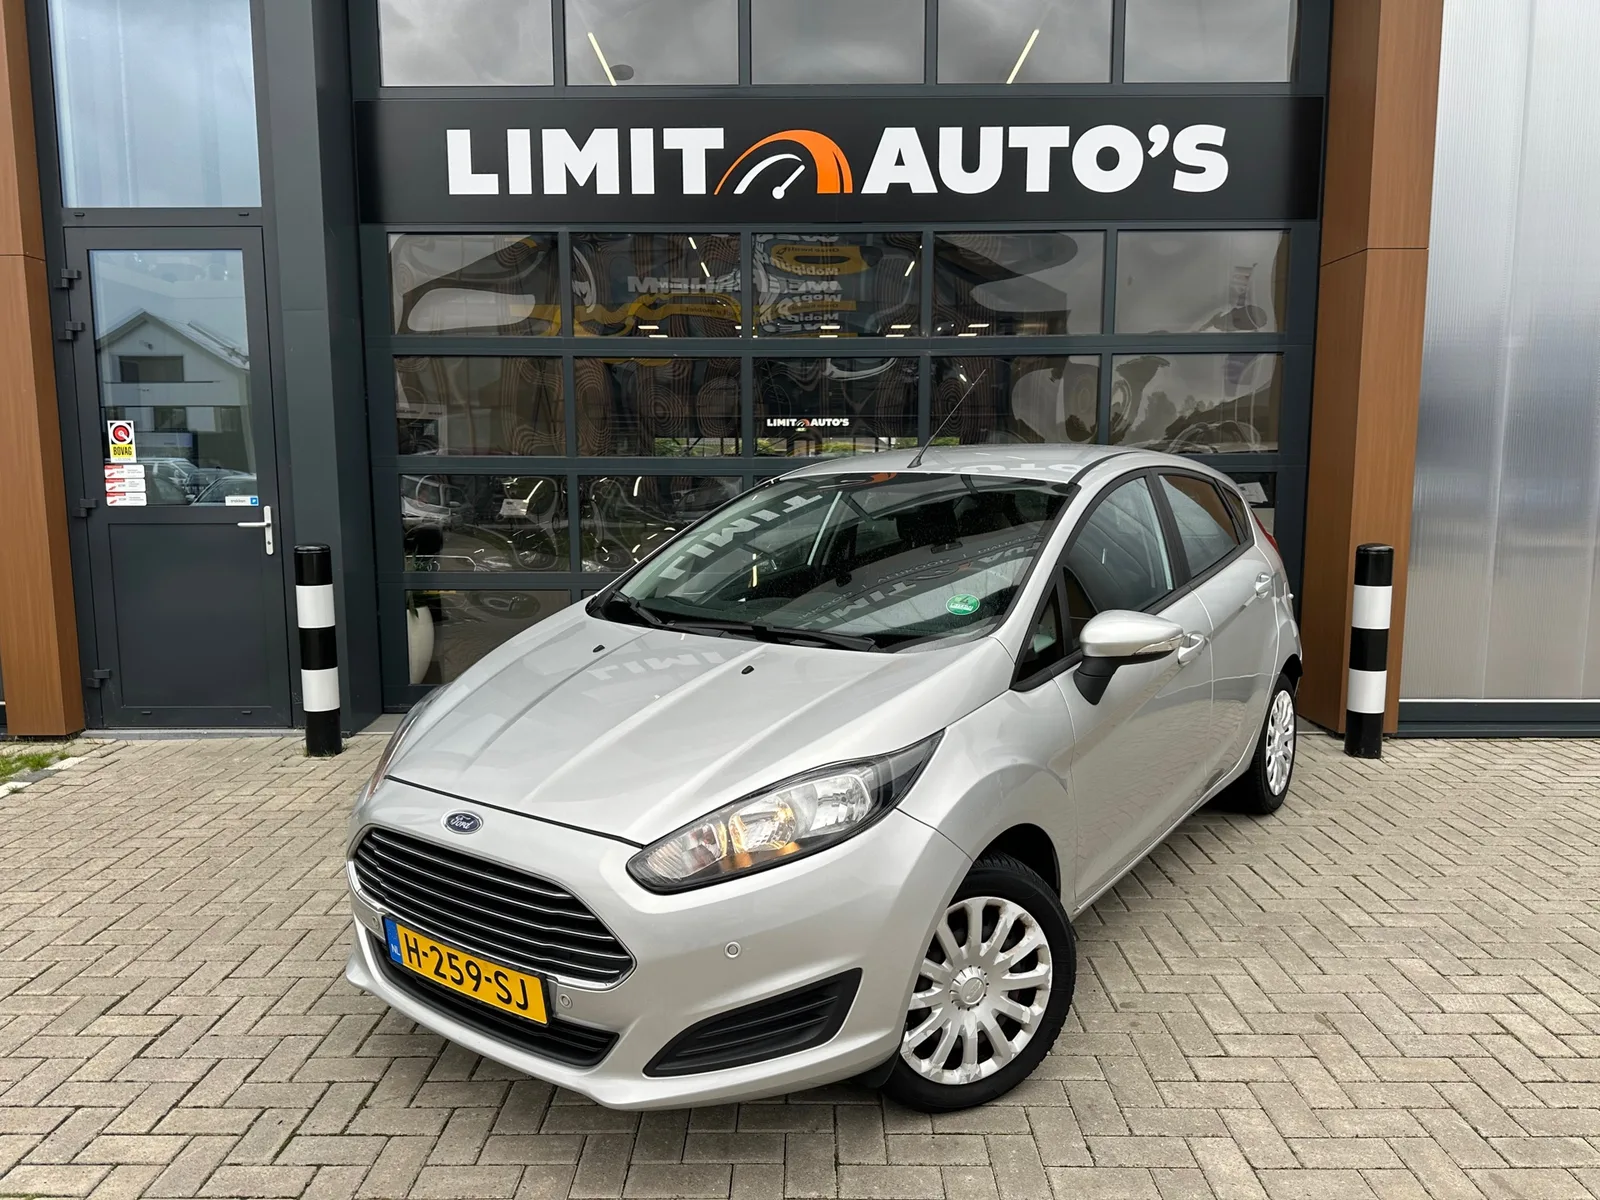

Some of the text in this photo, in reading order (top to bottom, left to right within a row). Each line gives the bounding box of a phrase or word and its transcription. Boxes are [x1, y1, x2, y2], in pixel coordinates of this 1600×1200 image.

[446, 123, 1229, 195] LIMIT AUTO'S
[766, 418, 850, 427] LIMIT AUTO'S
[112, 445, 133, 457] BOVAG
[450, 814, 474, 829] Ford
[390, 943, 401, 956] NL
[403, 932, 529, 1011] H-259-SJ
